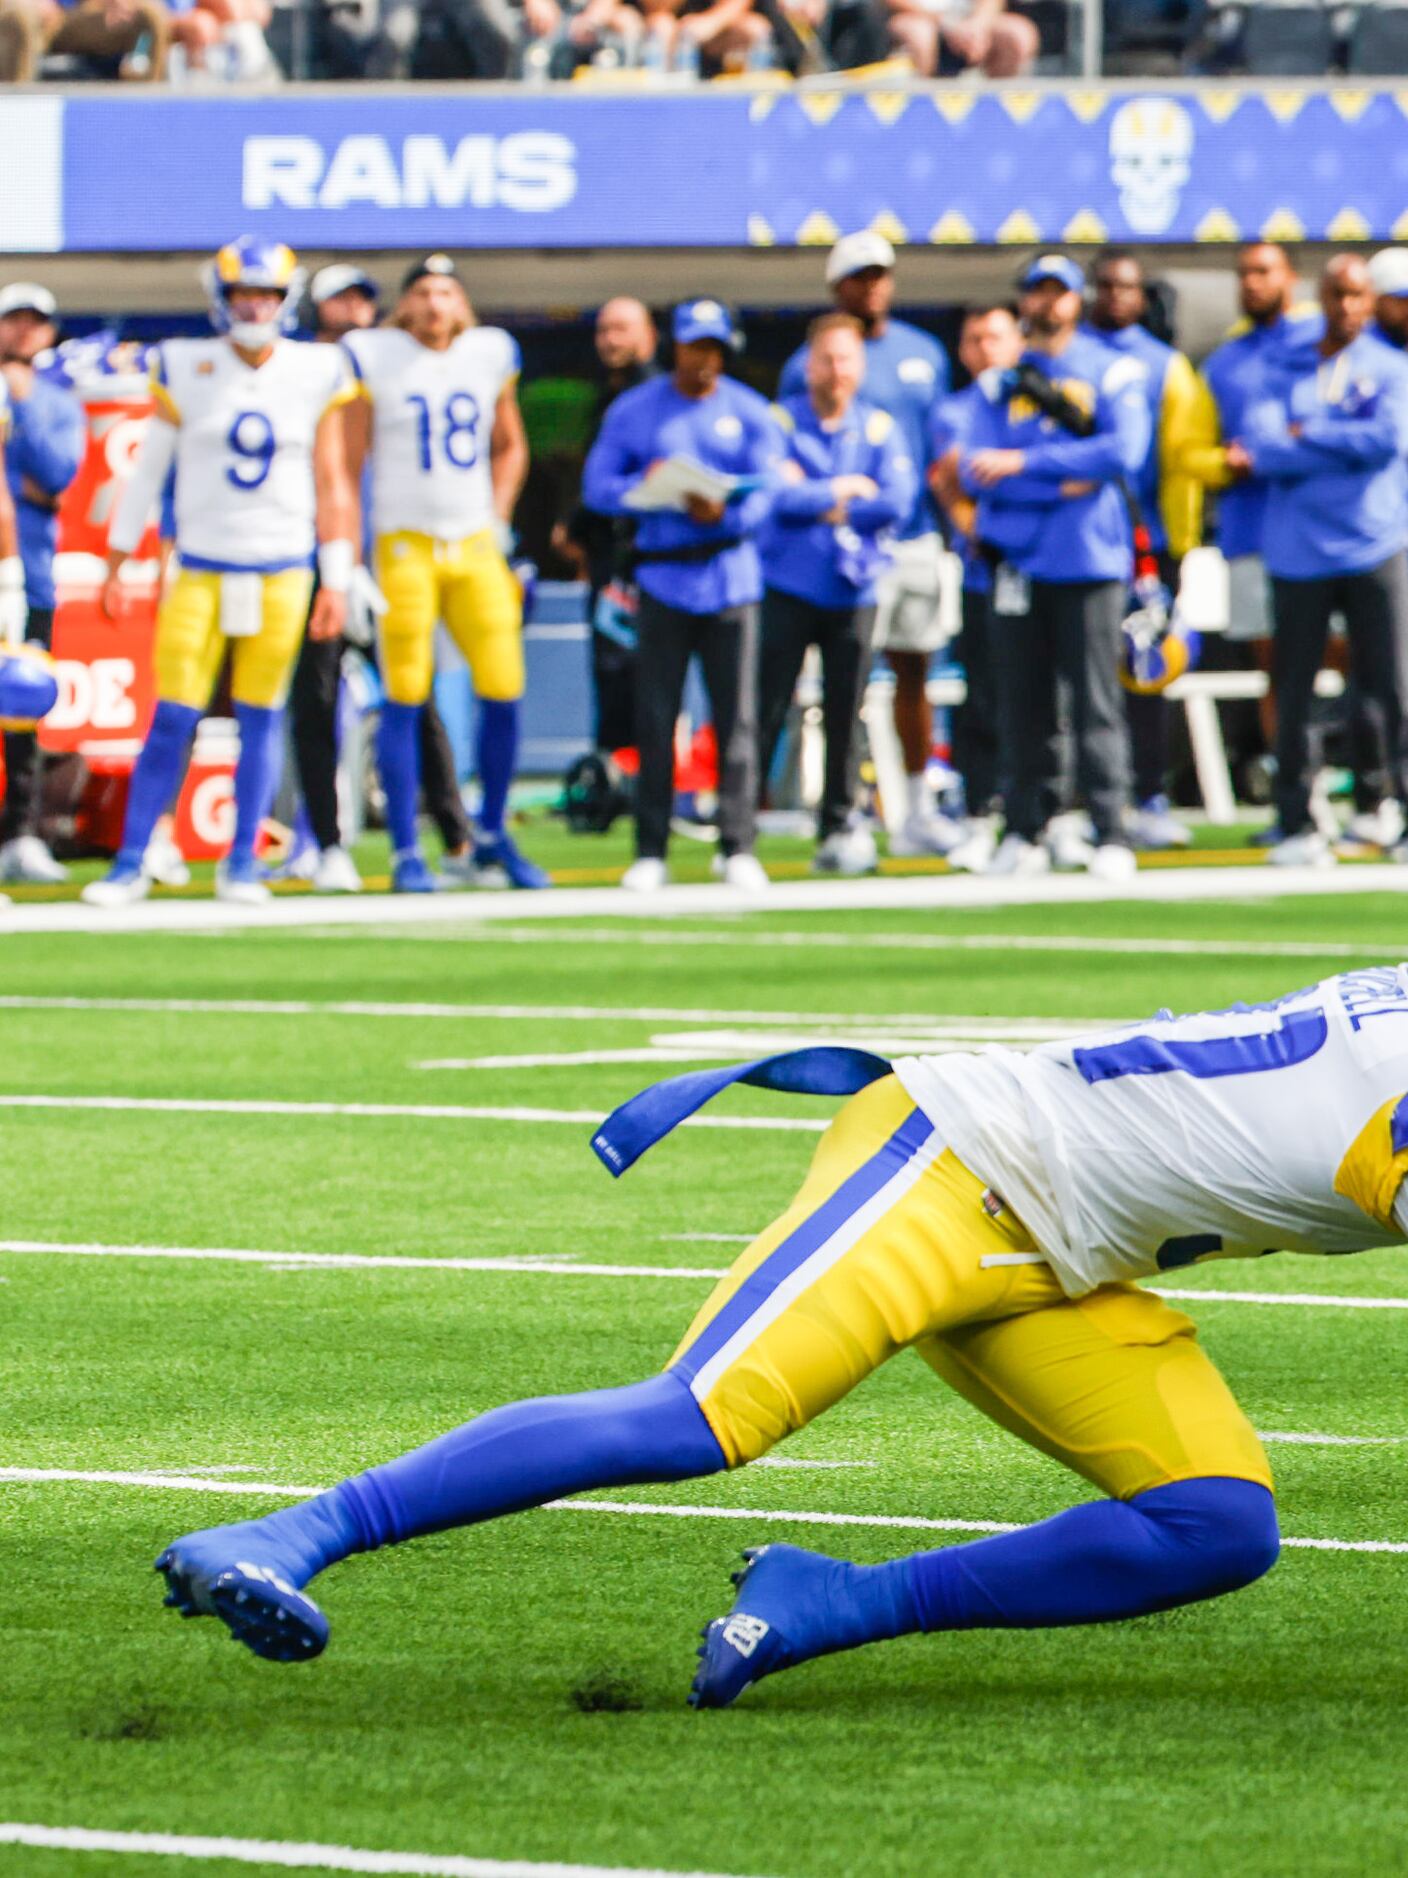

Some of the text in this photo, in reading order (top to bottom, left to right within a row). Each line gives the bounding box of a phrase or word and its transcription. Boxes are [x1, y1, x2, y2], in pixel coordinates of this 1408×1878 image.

[242, 131, 578, 212] RAMS
[228, 410, 276, 490] 9
[405, 391, 479, 473] 18
[43, 658, 136, 730] DE
[191, 773, 237, 844] G
